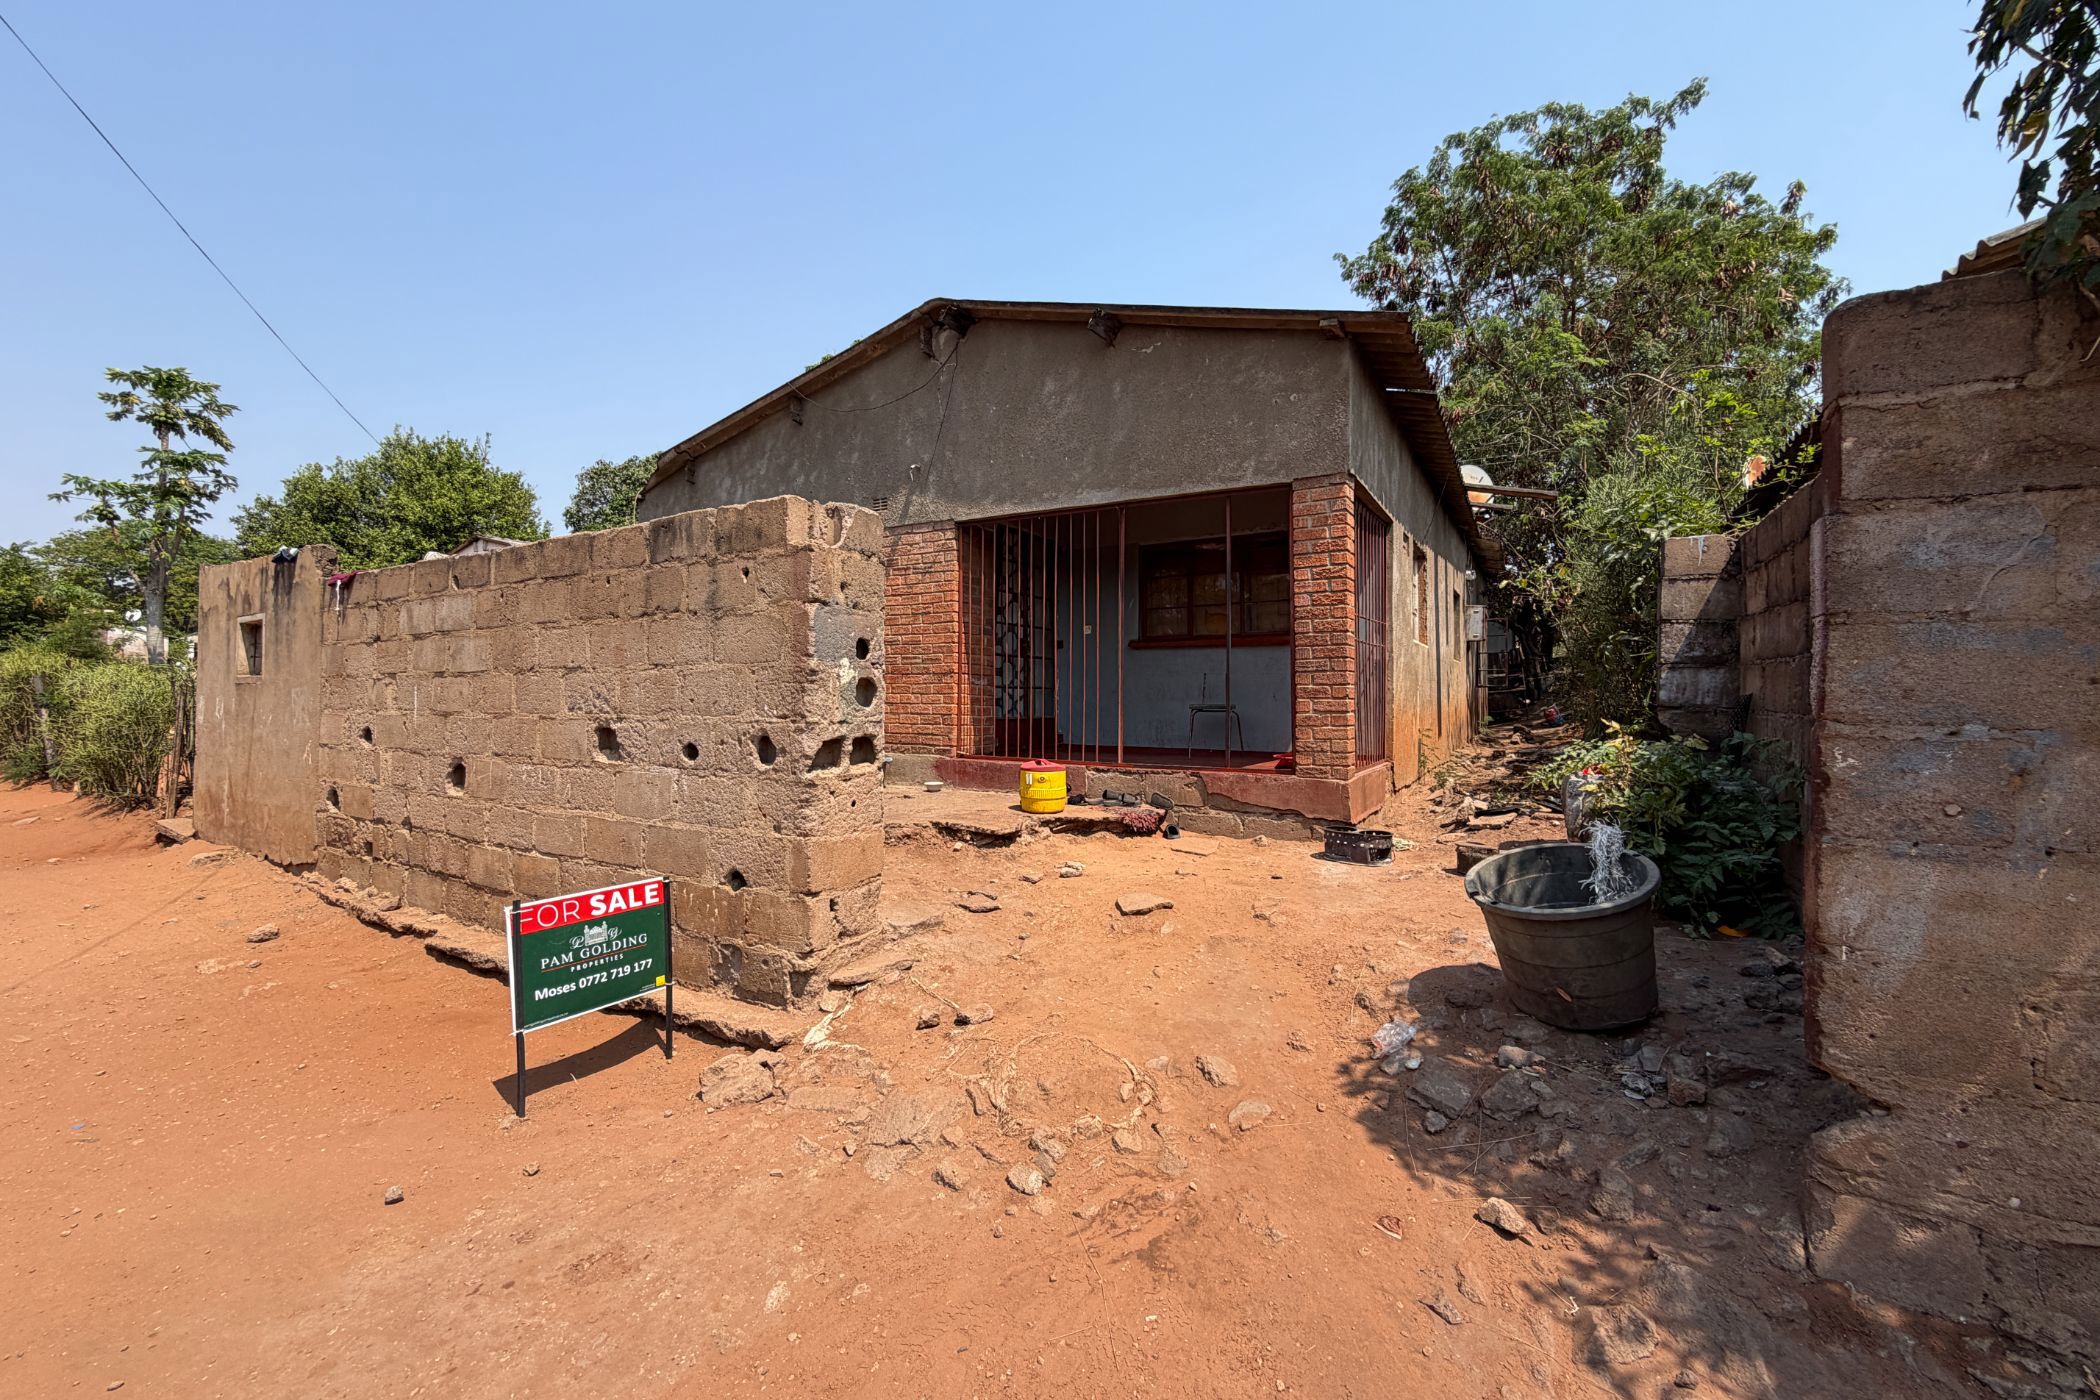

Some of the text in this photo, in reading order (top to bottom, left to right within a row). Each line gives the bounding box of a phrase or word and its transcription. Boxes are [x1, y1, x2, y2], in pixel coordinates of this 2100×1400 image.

[520, 883, 660, 927] FOR SALE
[540, 933, 648, 969] PAM GOLDING
[570, 953, 624, 972] PROPERTIES
[534, 958, 653, 1001] Moses 0772 719 177
